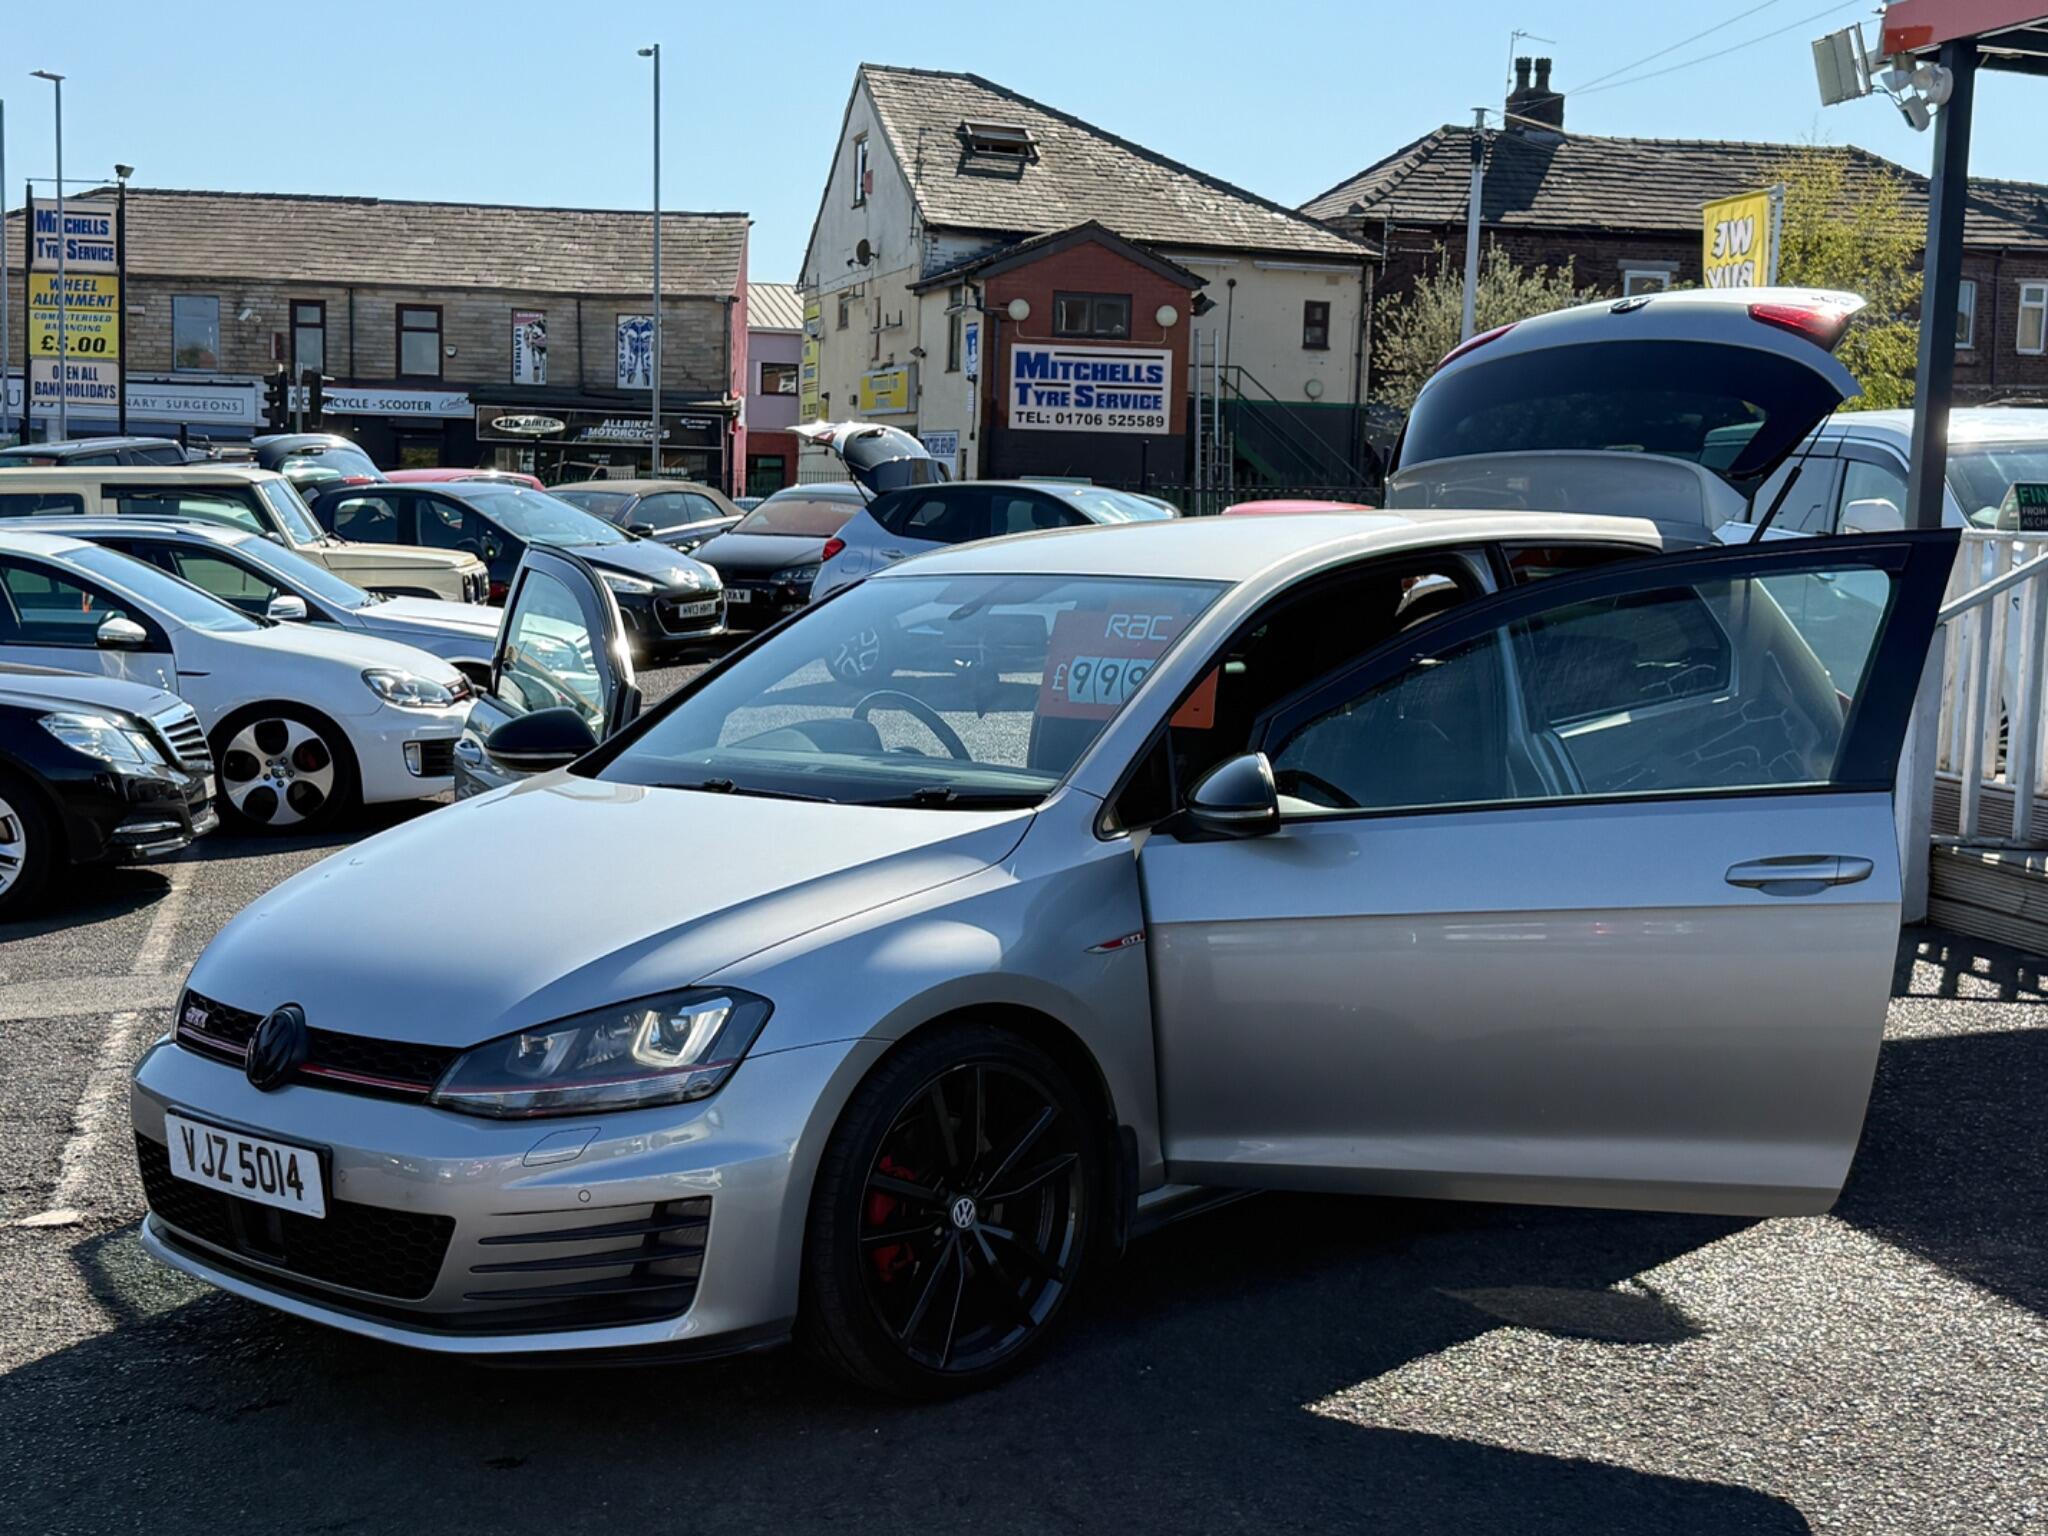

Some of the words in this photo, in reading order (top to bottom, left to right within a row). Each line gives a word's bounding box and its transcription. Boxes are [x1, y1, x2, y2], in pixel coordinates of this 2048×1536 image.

[36, 209, 109, 236] MICHELLS
[36, 237, 64, 259] TYR
[66, 239, 114, 261] SERVICE
[52, 365, 79, 380] OEN
[82, 366, 98, 381] ALL
[1015, 351, 1164, 384] MITCHELLS
[65, 383, 116, 399] HOLIDAYS
[1015, 382, 1070, 407] TYRE
[1074, 385, 1163, 411] SERVICE
[167, 399, 239, 412] SURGEONS
[379, 399, 432, 412] SCOOTER
[1015, 411, 1051, 424] TEL:
[1055, 412, 1103, 426] 01706
[1108, 414, 1165, 428] 525589
[180, 1125, 233, 1183] VJZ
[238, 1142, 305, 1201] 5014
